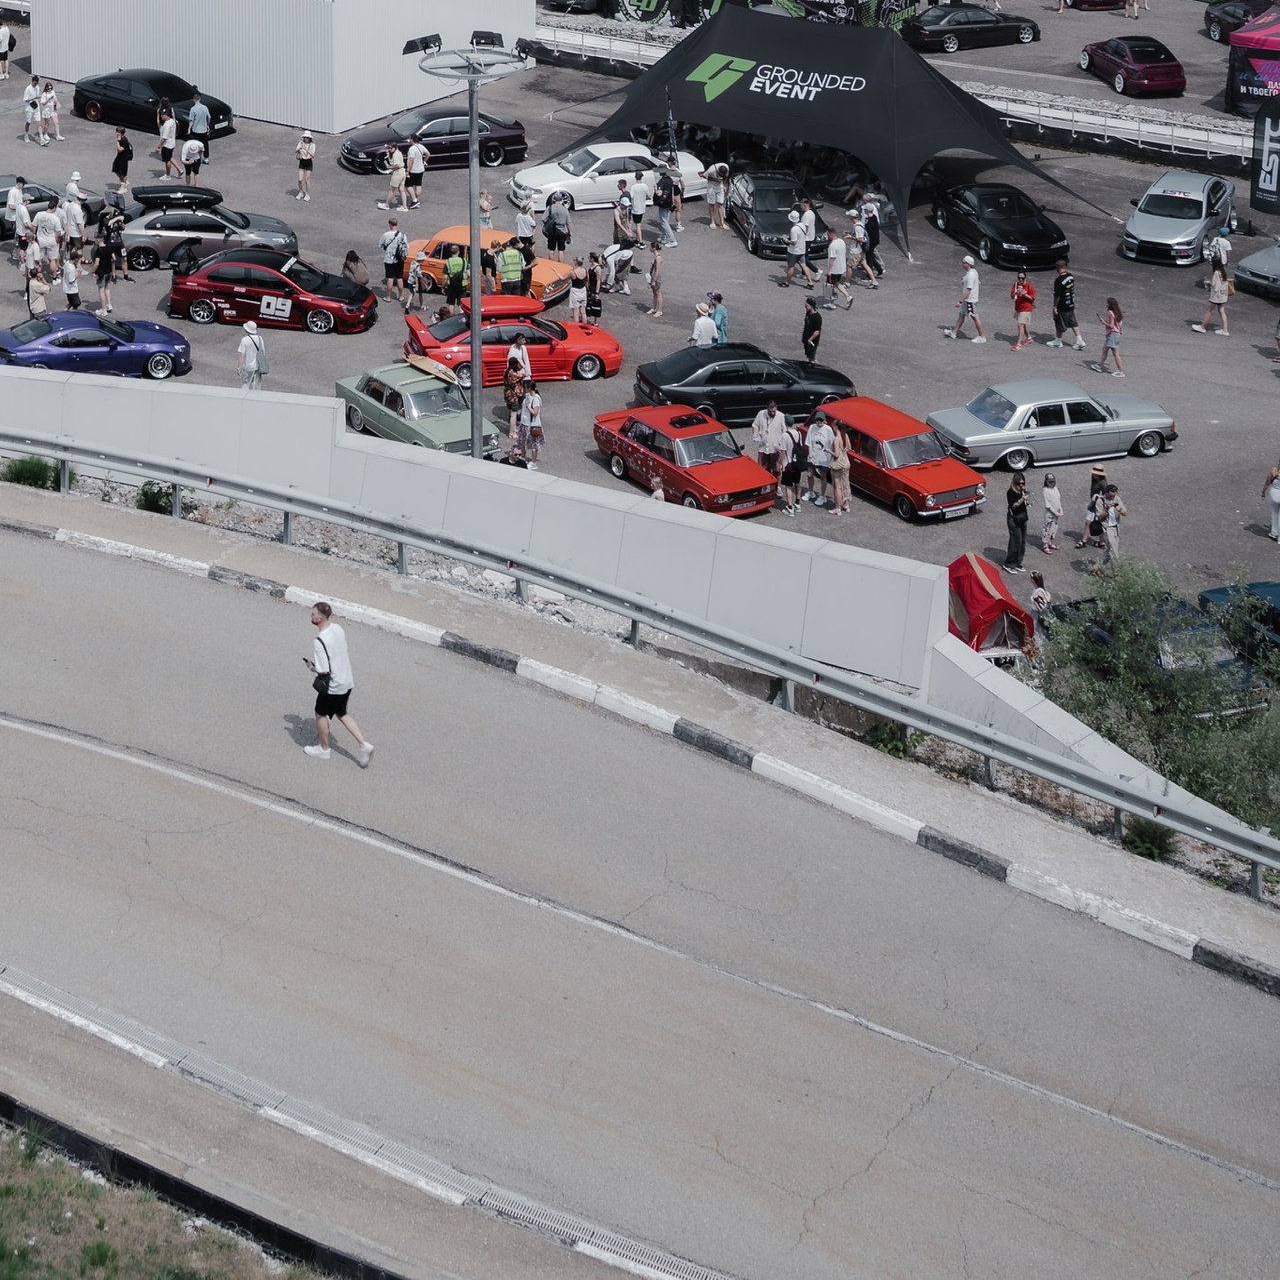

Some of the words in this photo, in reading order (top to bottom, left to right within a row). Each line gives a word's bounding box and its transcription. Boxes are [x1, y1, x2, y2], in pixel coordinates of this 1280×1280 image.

[749, 77, 822, 101] EVENT
[756, 64, 866, 92] GROUNDED
[1240, 85, 1246, 94] И
[1258, 117, 1280, 192] ESTC
[260, 294, 293, 318] 09
